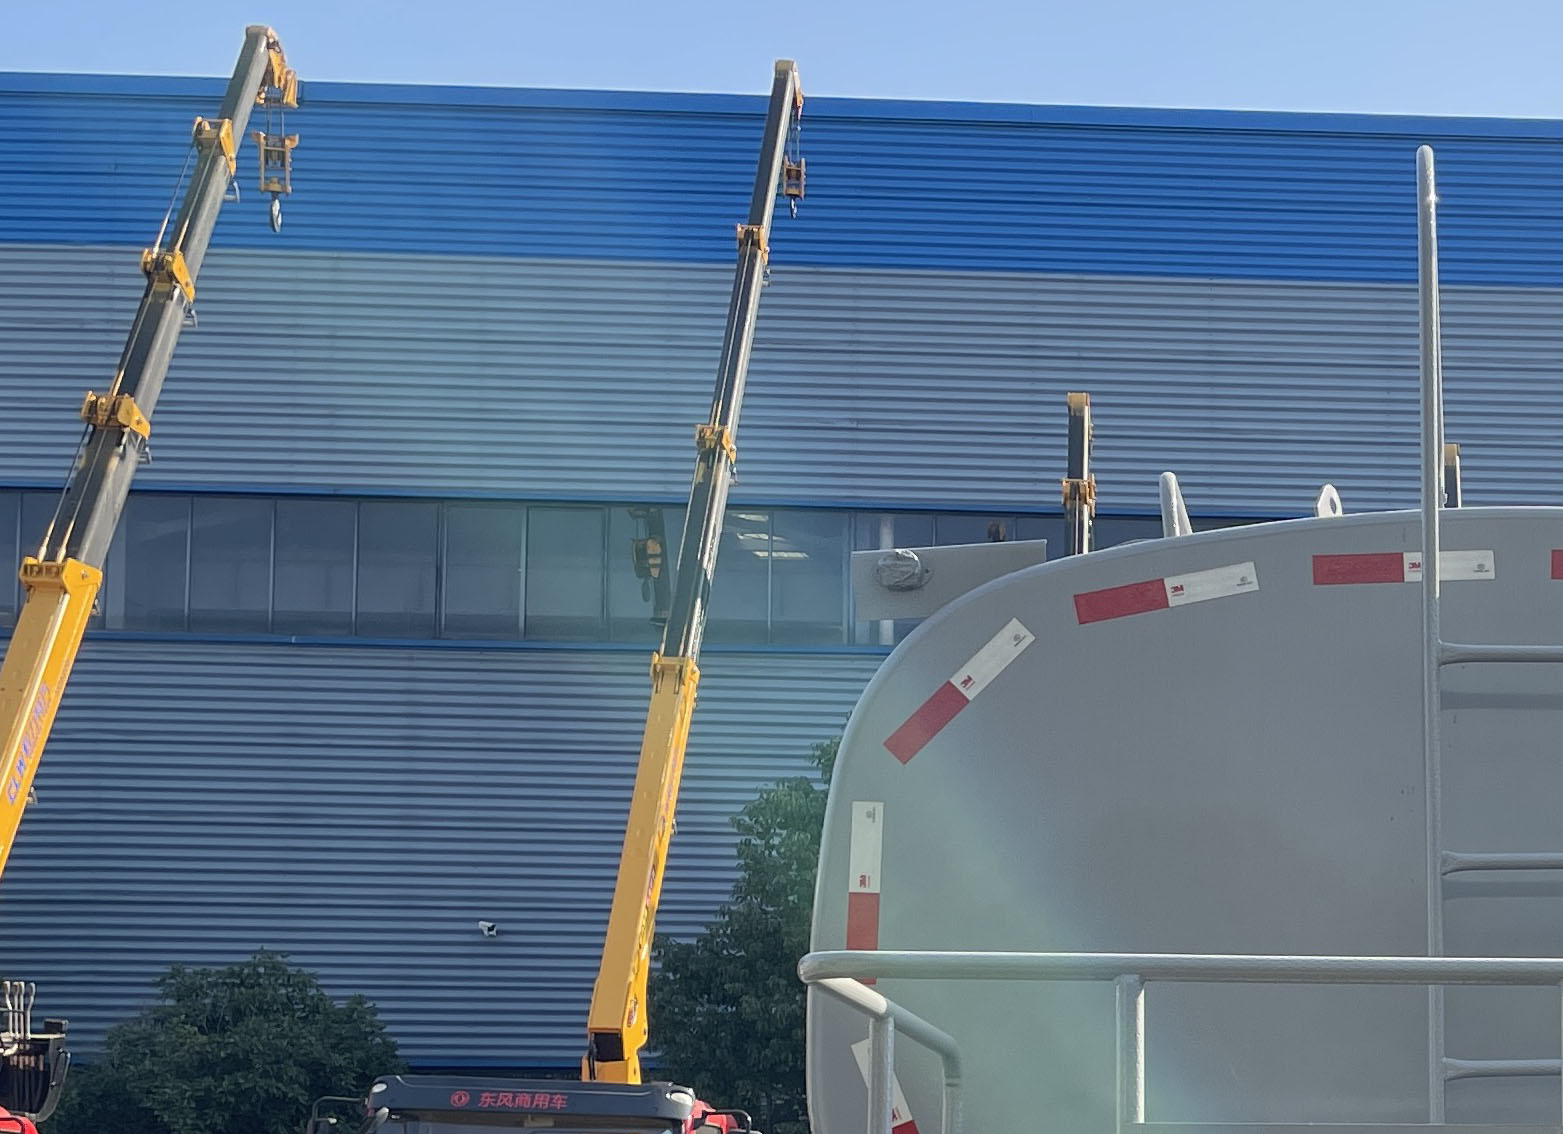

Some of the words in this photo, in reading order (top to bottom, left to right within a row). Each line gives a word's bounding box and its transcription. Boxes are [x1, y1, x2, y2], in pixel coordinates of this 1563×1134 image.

[478, 1092, 568, 1109] 东风商用车
